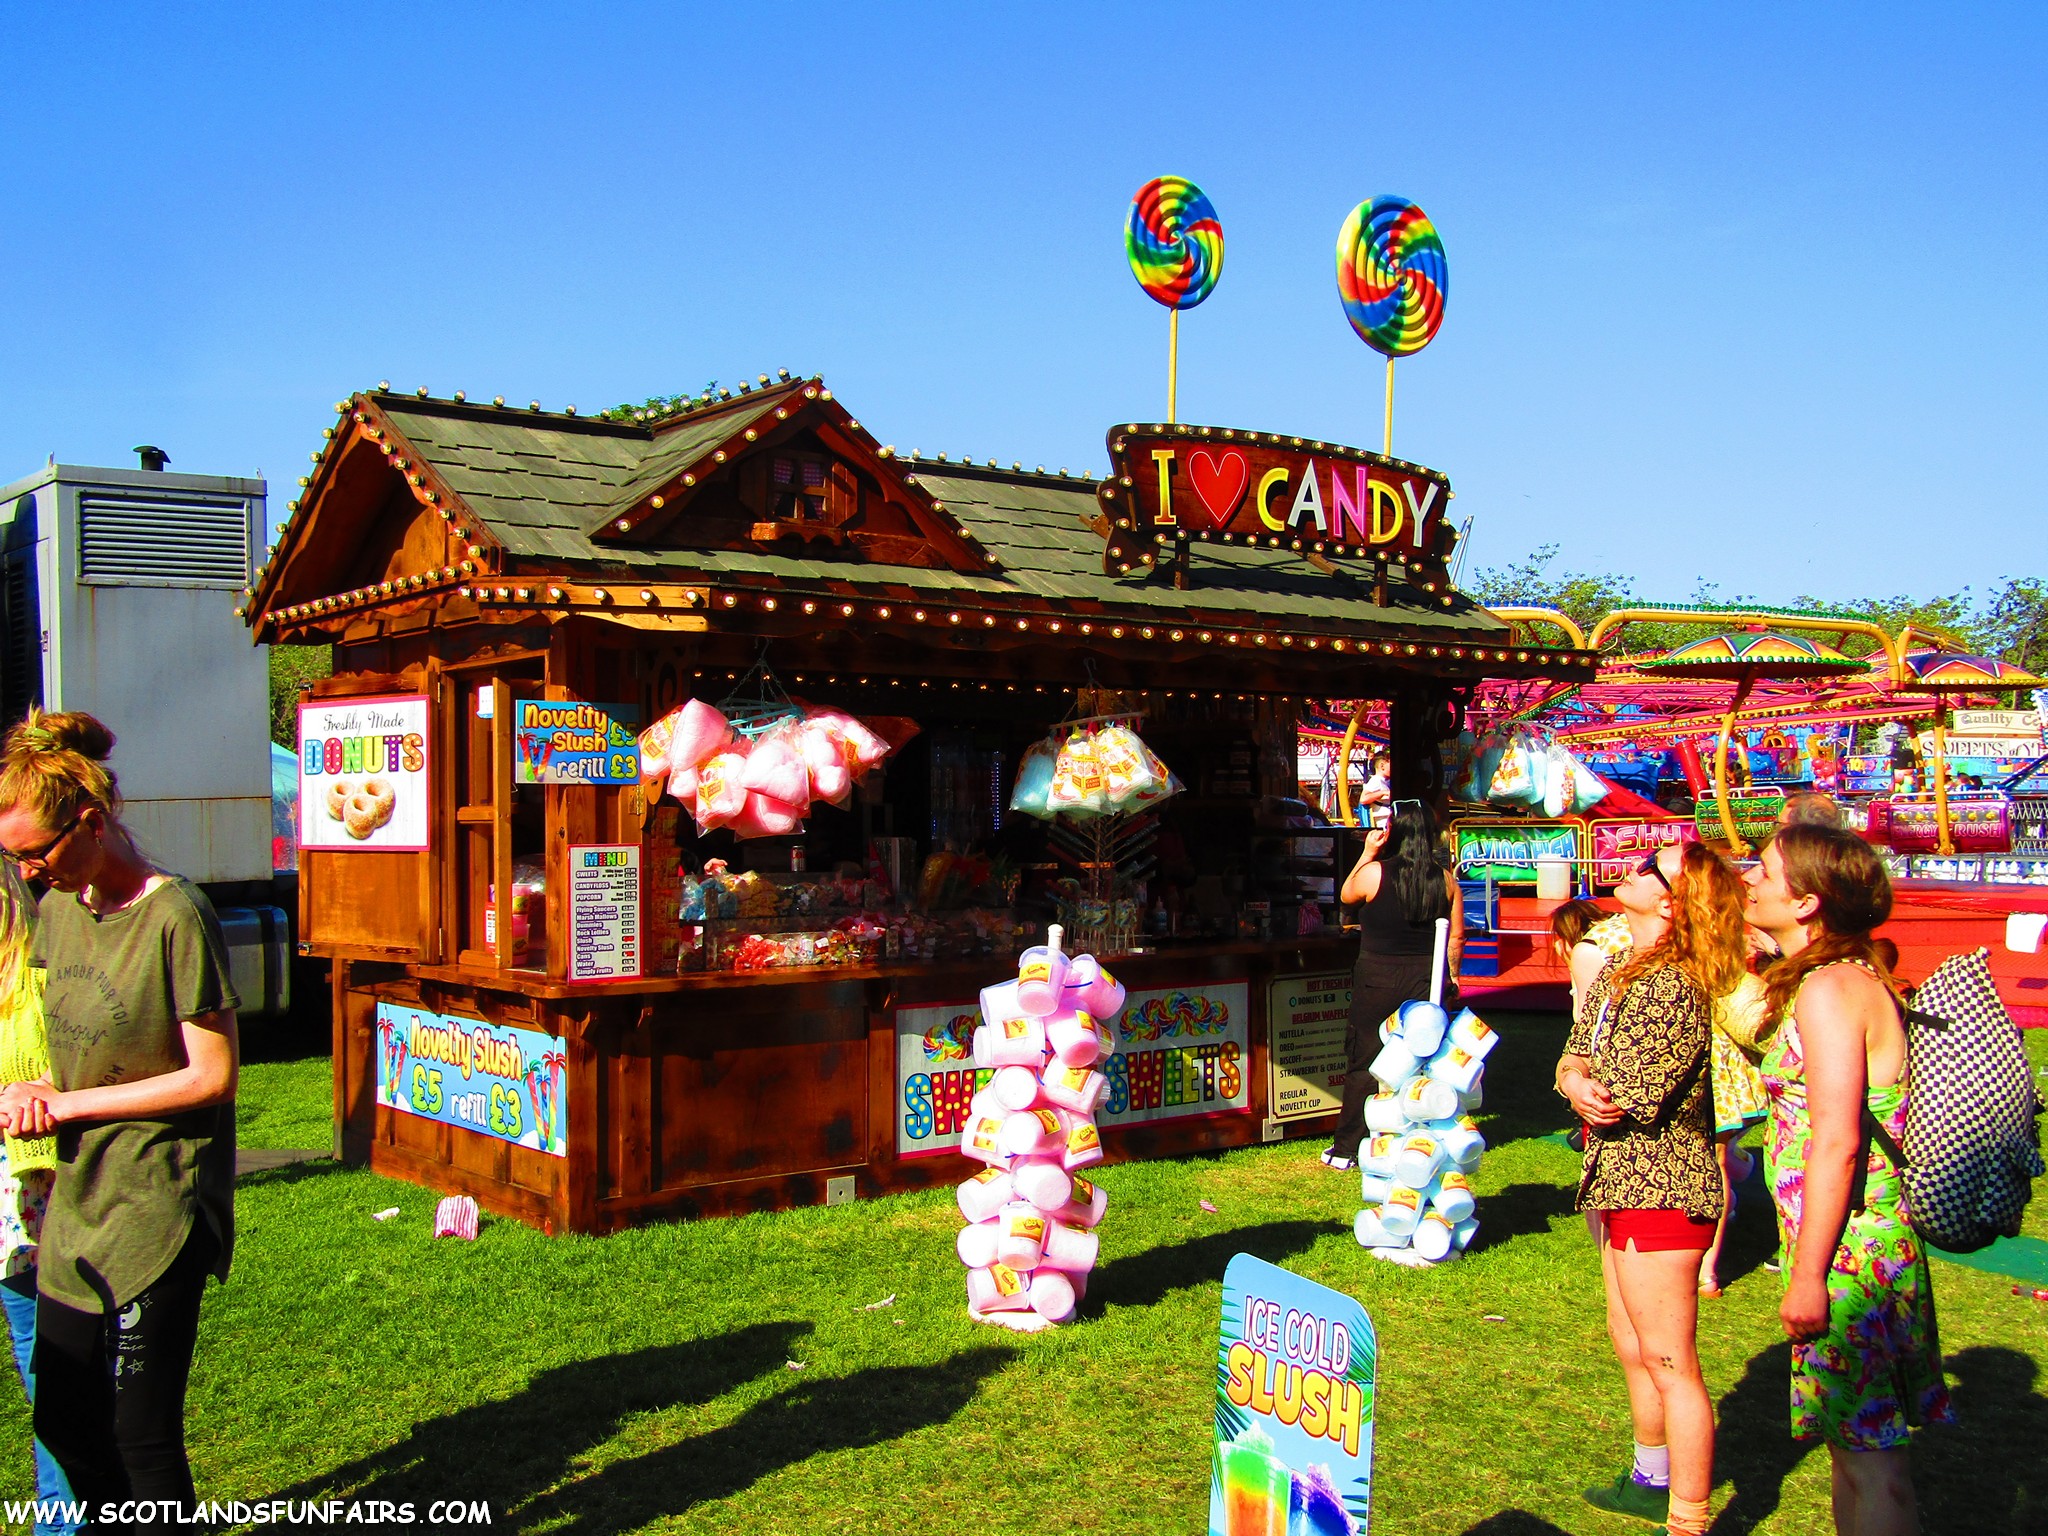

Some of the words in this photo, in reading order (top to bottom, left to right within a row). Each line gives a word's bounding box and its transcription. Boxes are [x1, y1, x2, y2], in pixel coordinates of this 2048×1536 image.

[1151, 449, 1177, 526] I
[1257, 458, 1440, 548] CANDY
[323, 713, 362, 735] Freshly
[368, 711, 405, 729] Made
[1961, 713, 2014, 727] Quality
[552, 731, 608, 753] Slush
[609, 721, 638, 747] £5
[304, 733, 425, 775] DONUTS
[556, 758, 607, 778] refill
[610, 754, 639, 779] £3
[1616, 824, 1682, 853] SKY
[1954, 823, 2001, 838] RUSH
[584, 852, 628, 867] MENU
[1461, 839, 1529, 874] FLYING
[576, 906, 593, 914] Flying
[1307, 980, 1321, 991] HOT
[1322, 979, 1343, 990] FRESH
[57, 964, 95, 982] AMOUR
[95, 971, 116, 1002] POUR
[109, 1001, 129, 1026] TOI
[1298, 995, 1322, 1006] DONUTS
[1292, 1011, 1321, 1025] BELGIUM
[1322, 1008, 1350, 1022] WAFFLE
[1279, 1029, 1305, 1039] NUTELLA
[473, 1027, 523, 1082] Slush
[1280, 1043, 1295, 1052] OREO
[1280, 1055, 1302, 1065] BISCOFF
[1104, 1041, 1241, 1115] SWEETS
[1280, 1066, 1319, 1079] STRAWBERRY
[1320, 1065, 1326, 1073] &
[1326, 1062, 1346, 1072] CREAM
[1328, 1075, 1346, 1087] SLUS
[411, 1063, 444, 1114] £5
[451, 1092, 488, 1127] refill
[489, 1082, 523, 1138] £3
[1280, 1089, 1308, 1100] REGULAR
[1280, 1101, 1308, 1112] NOVELTY
[1308, 1098, 1321, 1108] CUP
[1243, 1295, 1281, 1352] ICE
[1284, 1308, 1351, 1375] COLD
[1226, 1341, 1363, 1458] SLUSH
